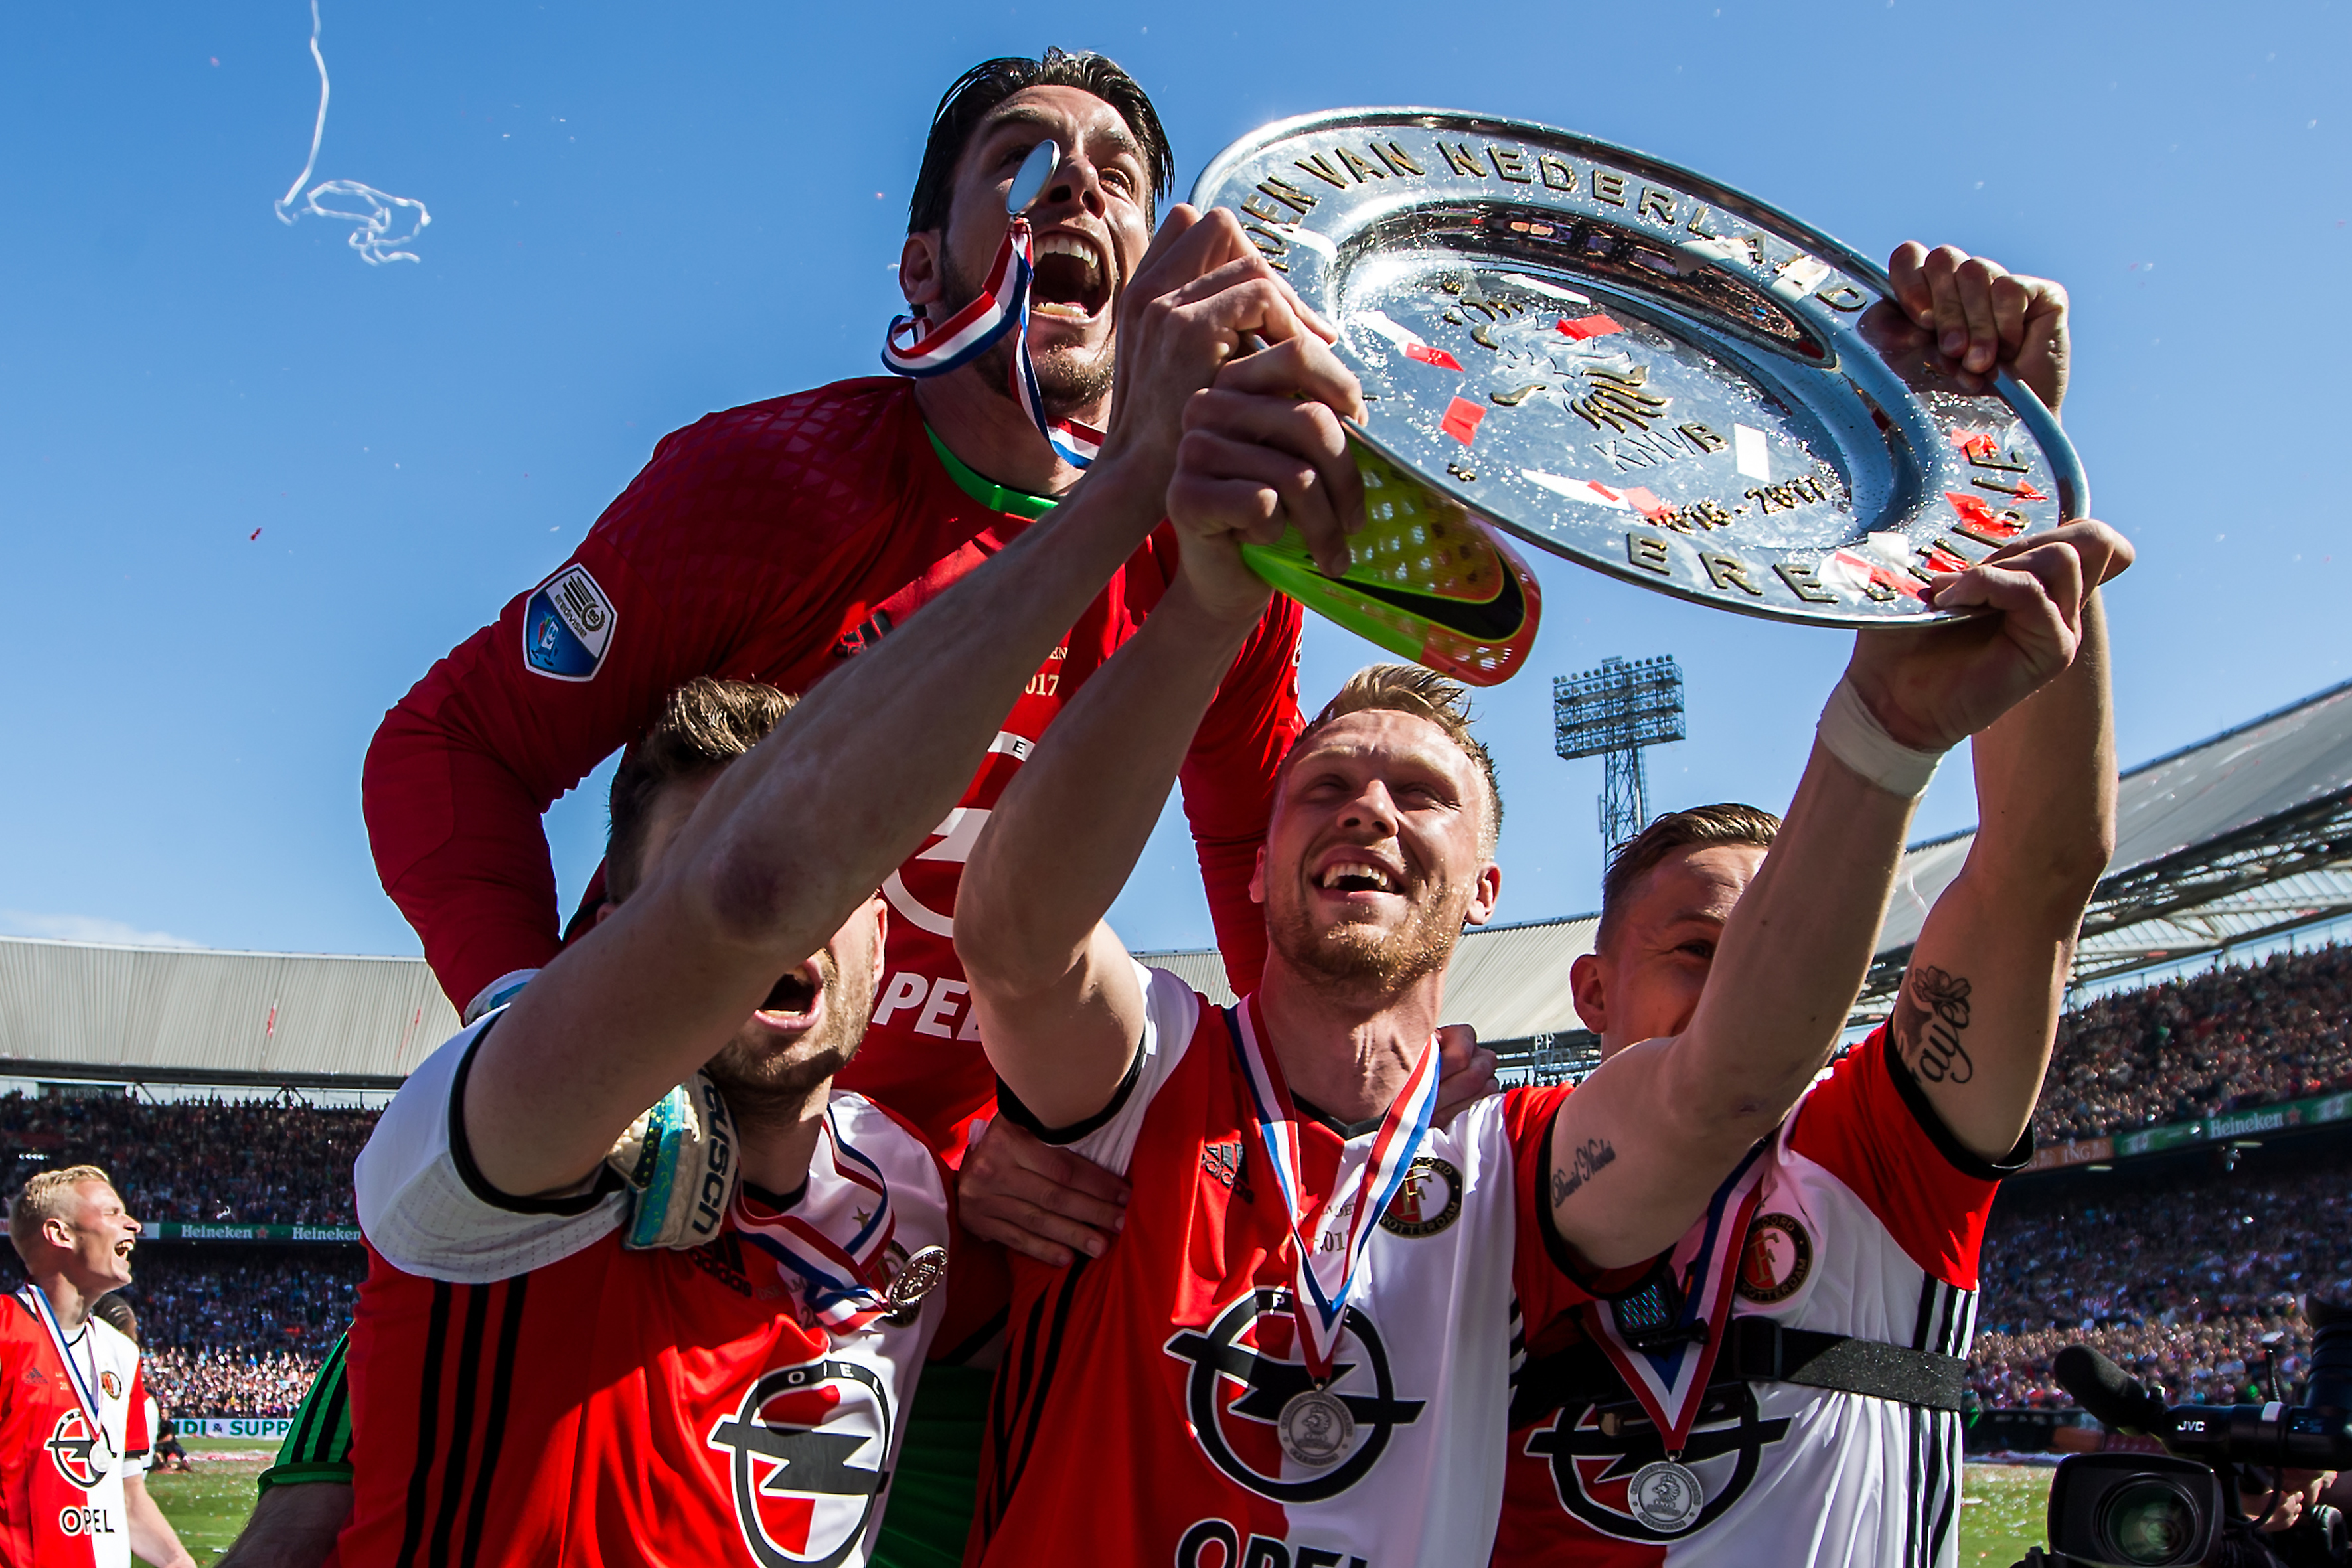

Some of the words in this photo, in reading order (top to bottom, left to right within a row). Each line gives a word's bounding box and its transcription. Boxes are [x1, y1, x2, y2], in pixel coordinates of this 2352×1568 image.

[1294, 141, 1425, 189] VAN
[1436, 141, 1868, 313] NEDERLAD
[2209, 1111, 2284, 1139] Heineken
[2063, 1146, 2090, 1163] ING
[181, 1225, 252, 1239] Heineken
[292, 1227, 362, 1241] Heineken
[2176, 1420, 2205, 1433] JVC
[59, 1506, 116, 1536] OPEL
